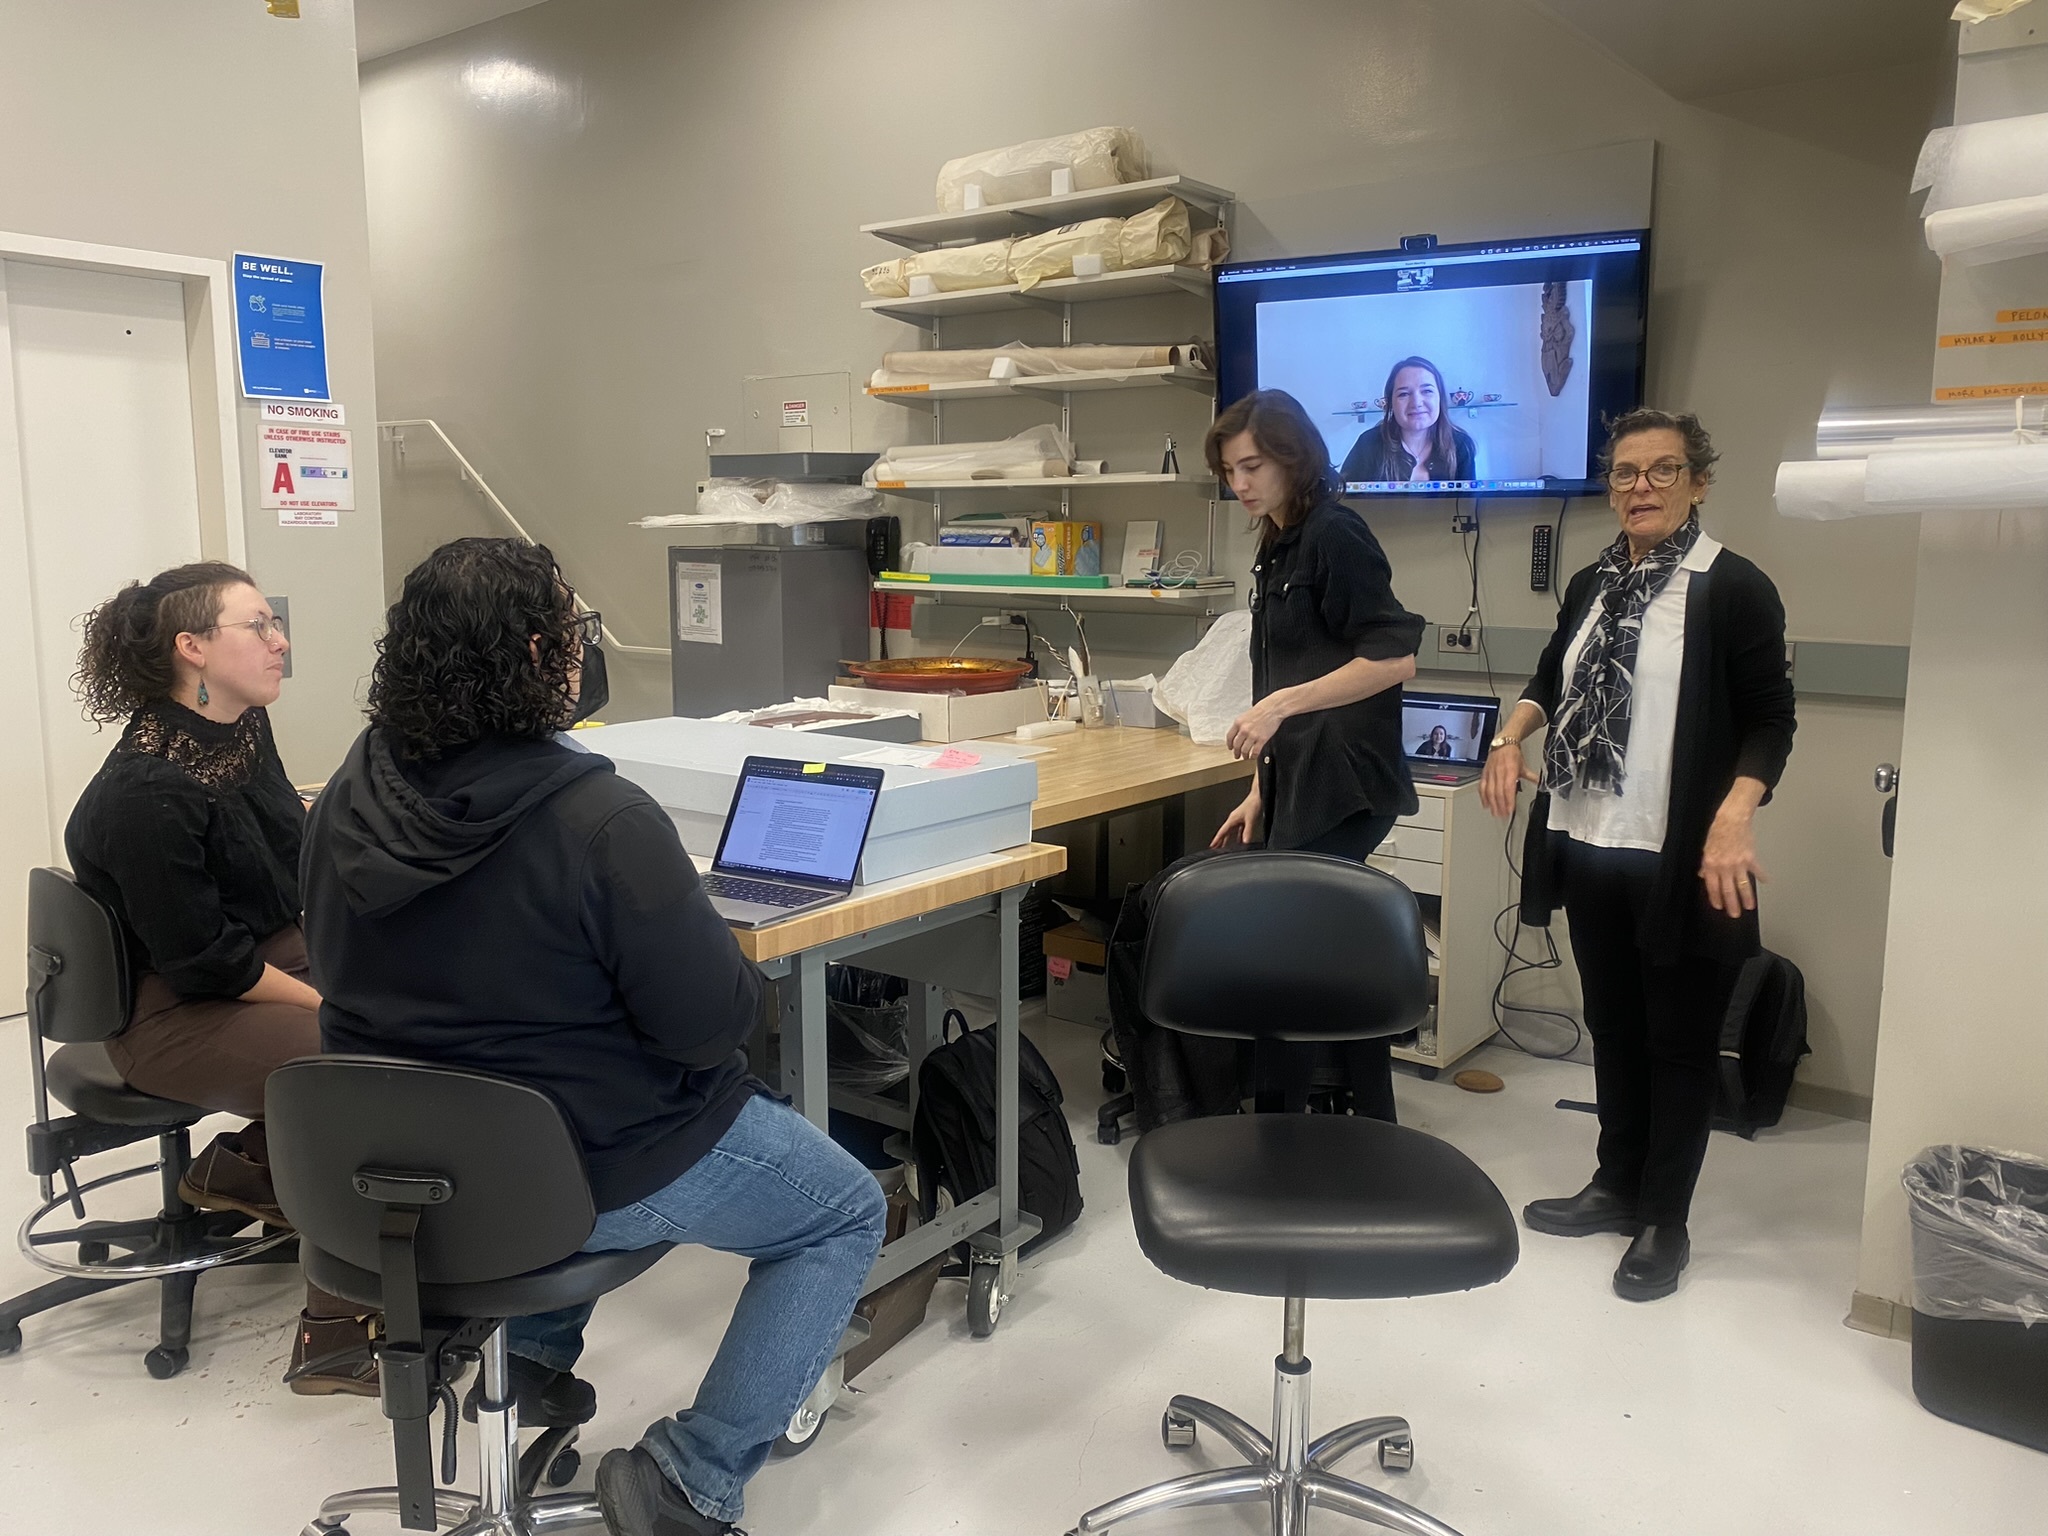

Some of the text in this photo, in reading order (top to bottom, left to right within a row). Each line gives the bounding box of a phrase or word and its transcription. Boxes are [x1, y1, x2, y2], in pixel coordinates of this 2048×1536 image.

[242, 261, 294, 276] BE WELL.
[1954, 335, 1985, 346] MYLAR
[267, 404, 338, 419] NO SMOKING
[272, 462, 295, 494] A
